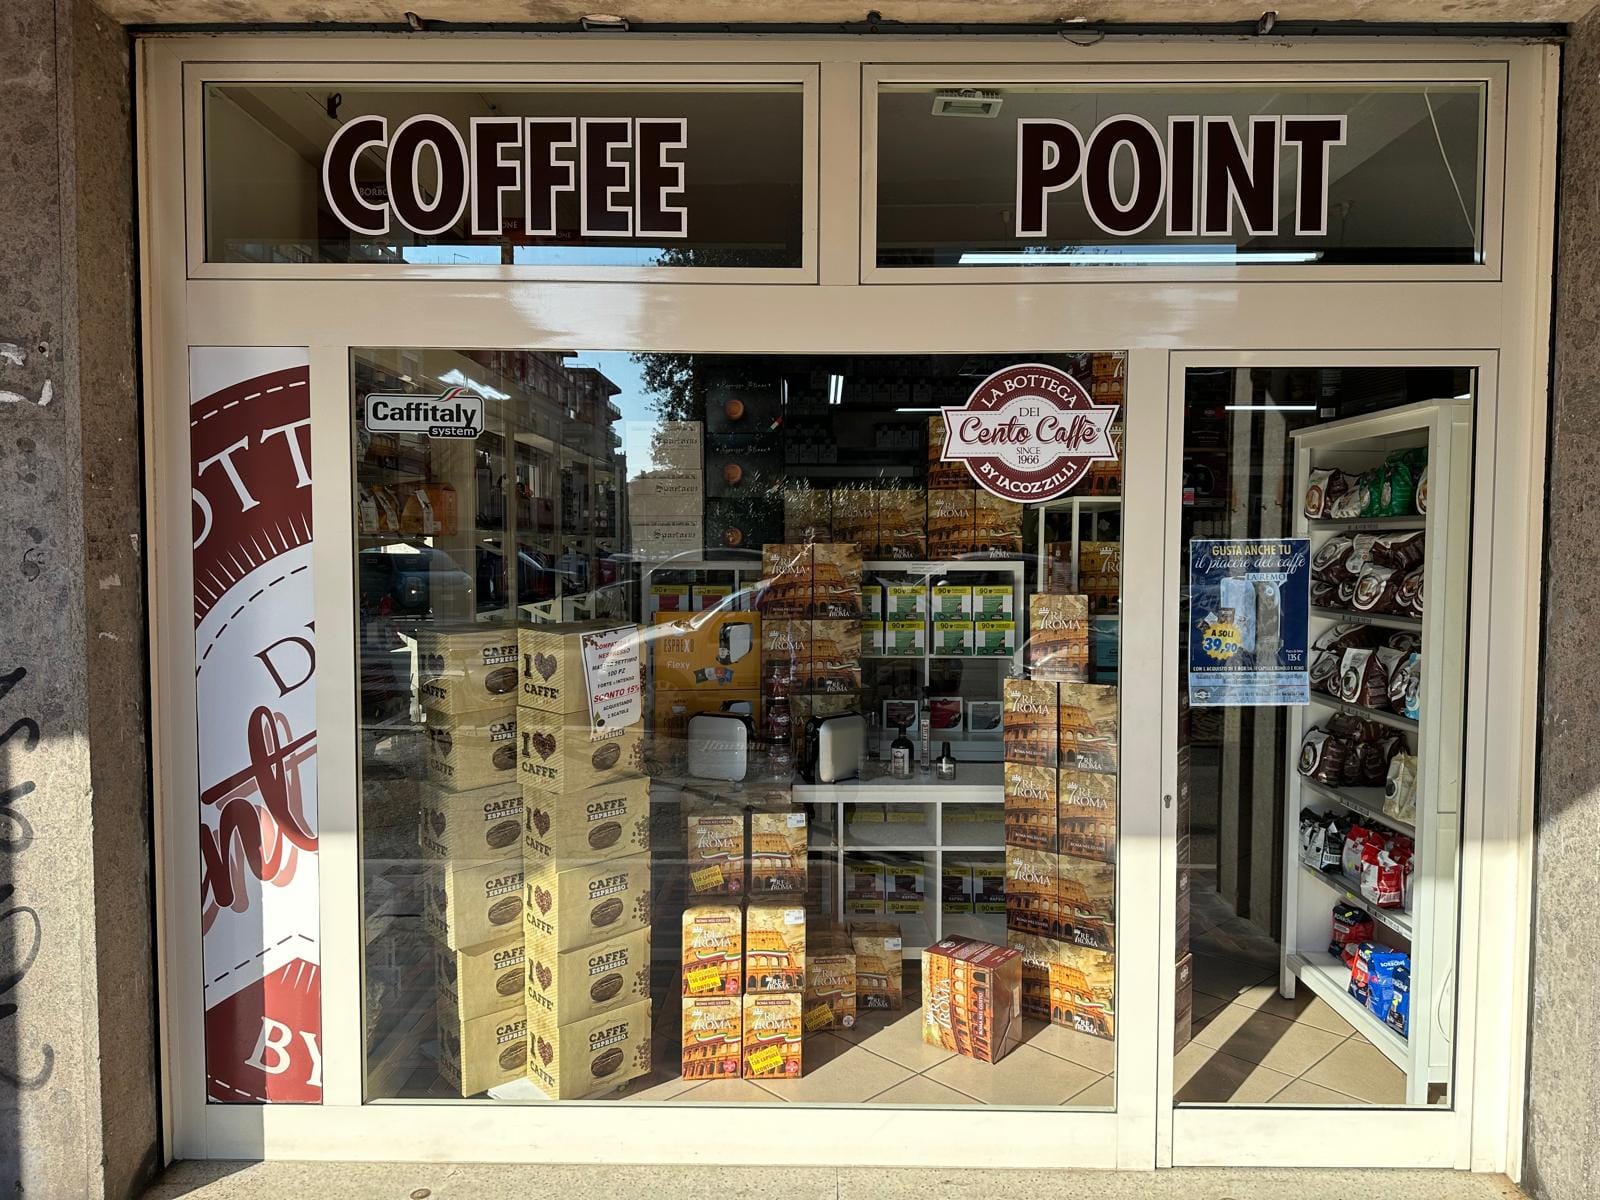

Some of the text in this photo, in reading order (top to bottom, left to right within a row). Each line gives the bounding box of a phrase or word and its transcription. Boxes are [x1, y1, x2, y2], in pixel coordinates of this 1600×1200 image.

[323, 114, 1347, 238] COFFEE POINT
[981, 374, 1077, 408] LA BOTTEGA
[372, 402, 476, 428] Caffitaly
[1020, 408, 1040, 416] DEI
[432, 427, 474, 436] system
[960, 415, 1098, 450] Cento Caffè
[1018, 455, 1039, 464] 1966
[980, 461, 1078, 493] BY IACOZZILLI
[1212, 544, 1291, 555] GUSTA ANCHE TU
[1195, 553, 1306, 574] il piacere del caffè
[1046, 620, 1080, 630] ROMA
[776, 642, 805, 650] ROMA
[1204, 638, 1237, 653] 39,90
[668, 660, 690, 670] Flexy
[593, 684, 640, 702] SCONTO 15%
[1017, 703, 1050, 714] ROMA
[1018, 789, 1049, 800] ROMA
[1074, 796, 1107, 808] ROMA
[587, 798, 626, 813] CAFFE'
[591, 808, 625, 820] ESPRESSO
[702, 839, 735, 848] ROMA
[589, 873, 628, 890] CAFFE'
[1019, 873, 1050, 885] ROMA
[592, 884, 626, 898] ESPRESSO
[526, 914, 553, 935] CAFFE'
[699, 938, 732, 948] ROMA
[589, 948, 628, 967] CAFFE'
[592, 959, 626, 975] ESPRESSO
[818, 976, 848, 985] ROMA
[528, 986, 553, 1010] CAFFE'
[939, 979, 950, 1022] ROMA
[699, 1020, 732, 1030] ROMA
[760, 1020, 792, 1029] ROMA
[589, 1023, 629, 1043] CAFFE'
[592, 1034, 626, 1050] ESPRESSO
[245, 1014, 322, 1086] BY
[530, 1061, 555, 1086] CAFFE'
